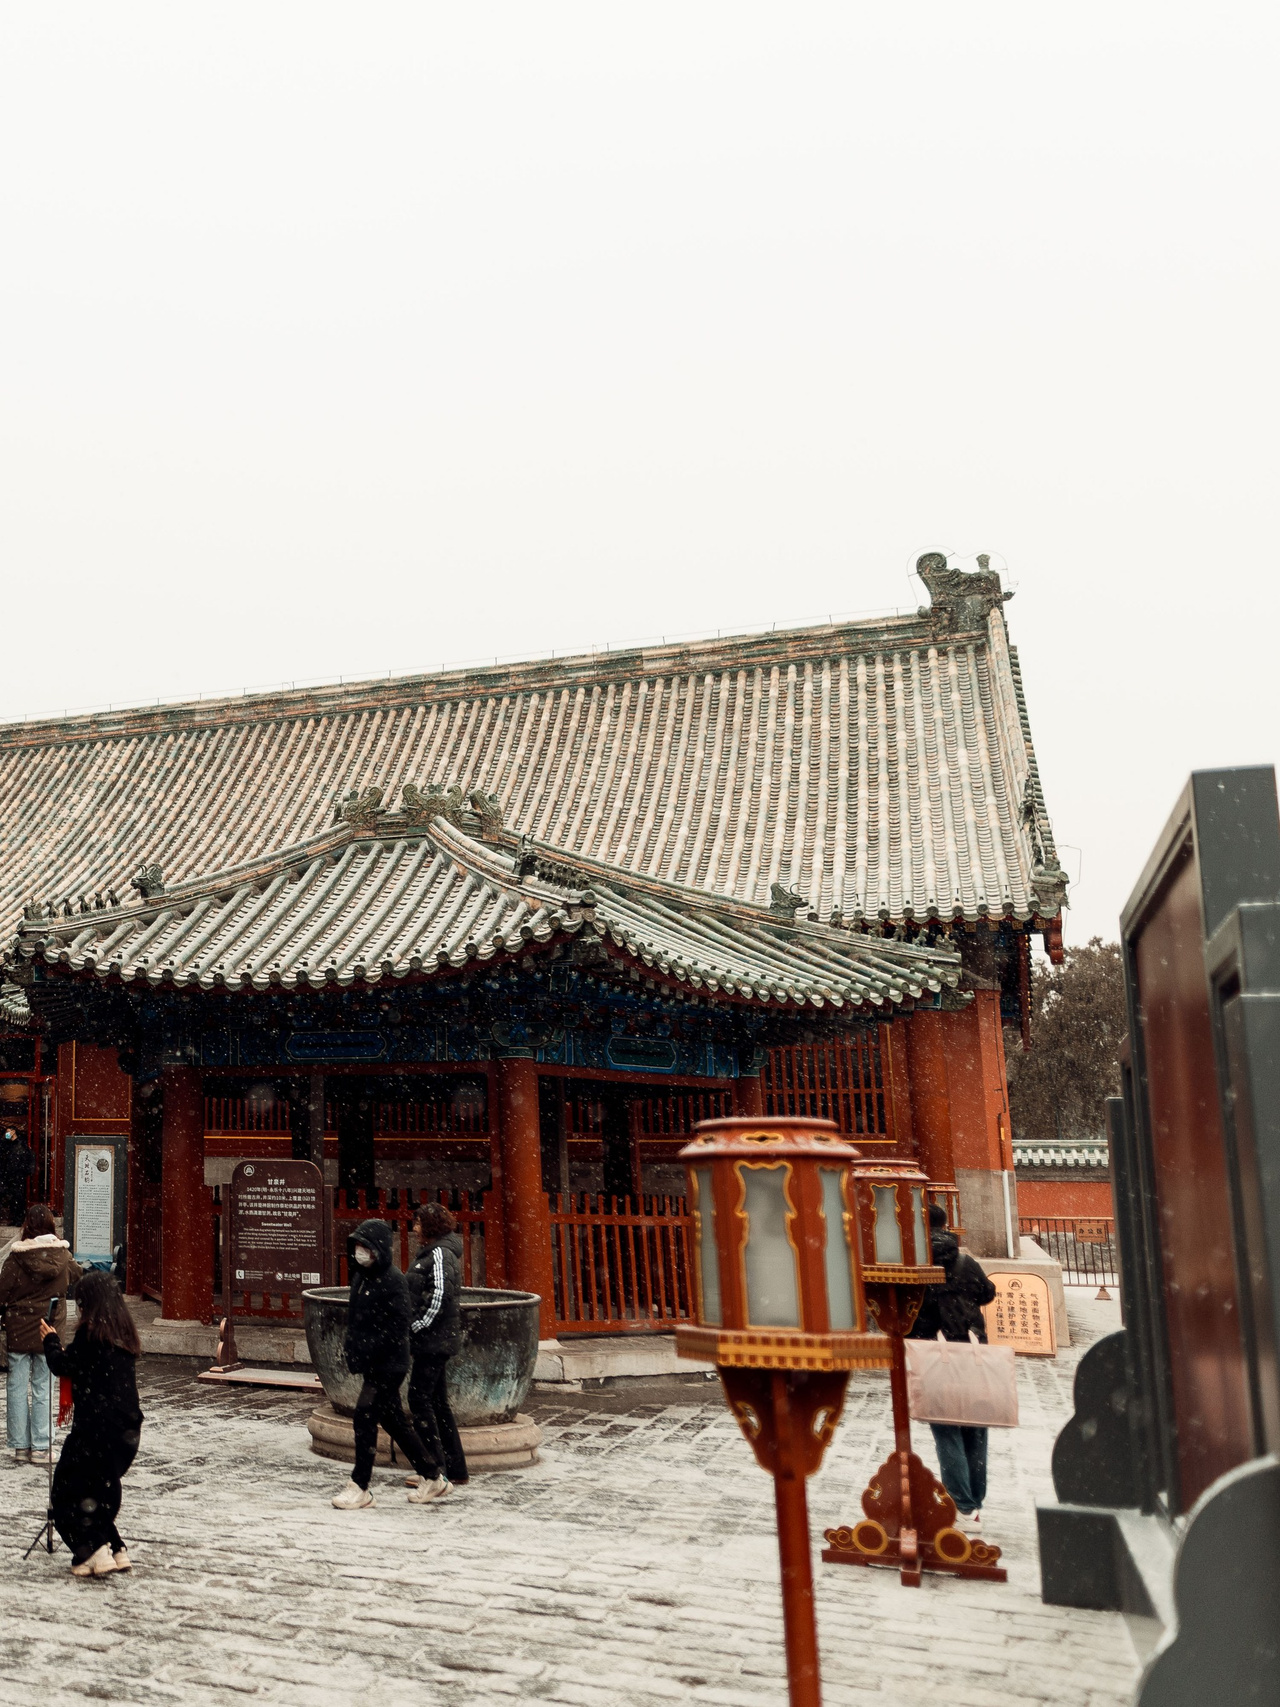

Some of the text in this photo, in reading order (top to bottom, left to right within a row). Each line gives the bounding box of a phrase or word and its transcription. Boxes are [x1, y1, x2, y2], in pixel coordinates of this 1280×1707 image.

[995, 1299, 1039, 1307] 小心地滑
[996, 1313, 1040, 1321] 保护文物
[997, 1320, 1041, 1328] 注意安全
[997, 1327, 1042, 1335] 禁止吸烟
